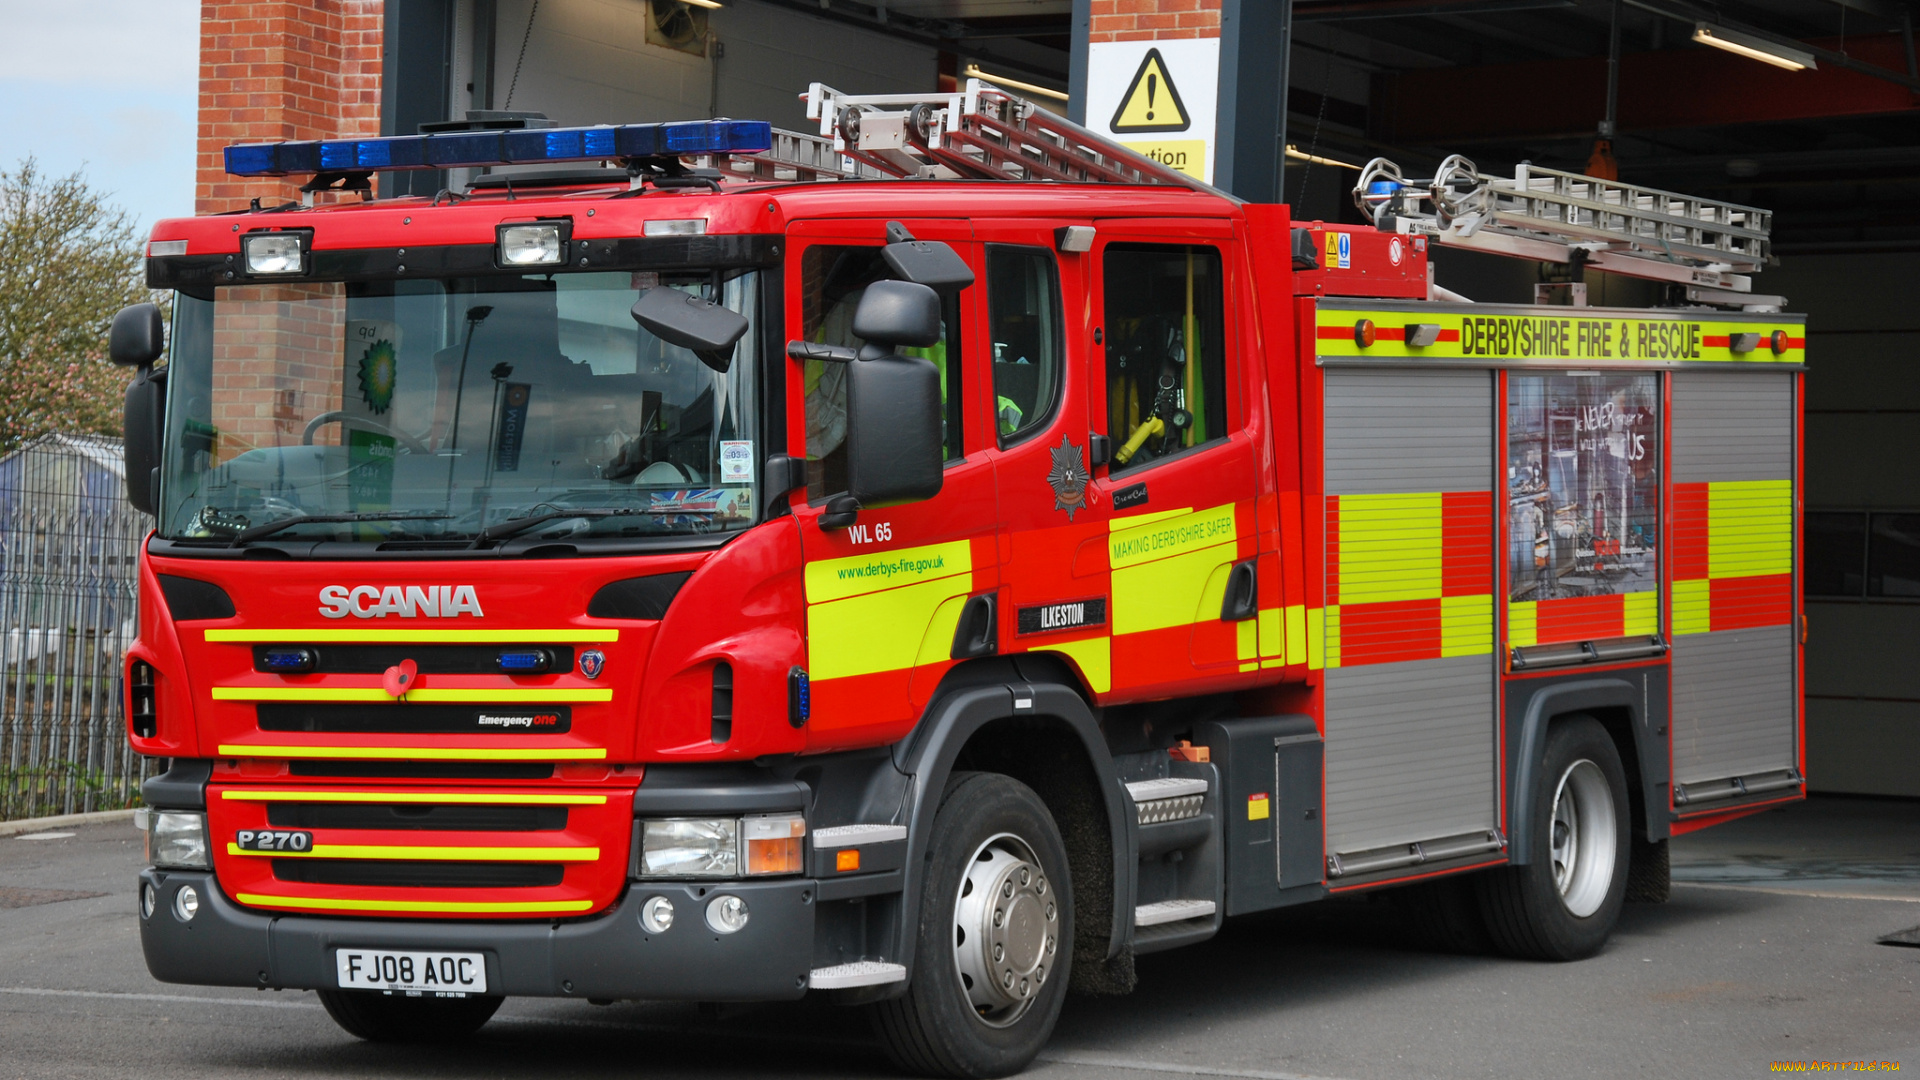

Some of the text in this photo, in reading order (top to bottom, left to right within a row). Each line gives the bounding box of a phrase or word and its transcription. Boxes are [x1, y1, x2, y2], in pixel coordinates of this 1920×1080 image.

[1462, 317, 1700, 359] DERBYSHIRE FIRE & RESCUE
[1583, 402, 1615, 431] NEVER
[1627, 429, 1646, 460] US
[848, 522, 892, 544] WL 65
[1113, 516, 1233, 559] MAKING DERBYSHIRE SAFER
[837, 555, 944, 580] www.derbys-fire.gov.uk
[318, 585, 484, 618] SCANIA
[1041, 603, 1084, 628] ILKESTON
[238, 831, 307, 850] P 270
[348, 955, 474, 985] FJ08 AOC
